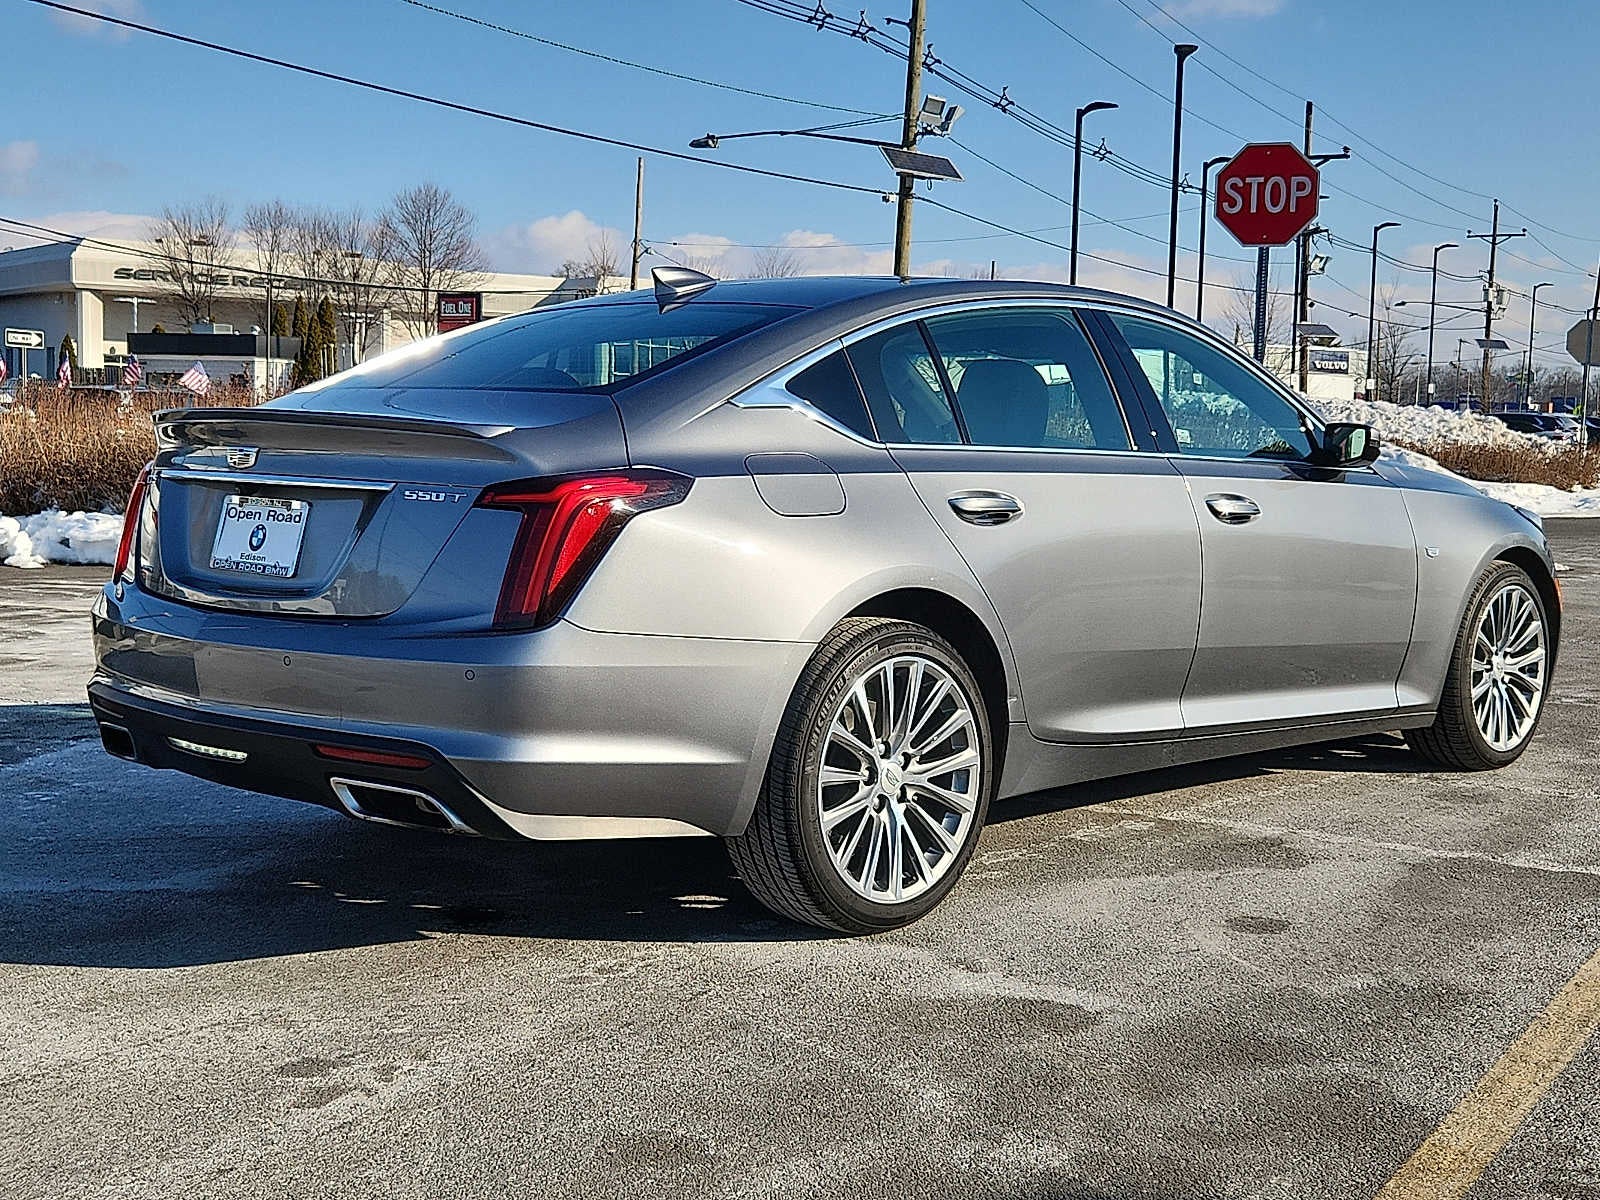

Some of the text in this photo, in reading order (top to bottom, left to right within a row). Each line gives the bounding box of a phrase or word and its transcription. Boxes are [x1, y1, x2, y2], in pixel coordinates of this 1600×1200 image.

[1222, 176, 1312, 214] STOP
[441, 301, 471, 313] FUEL ONE
[1314, 361, 1347, 370] VOLVO
[227, 506, 303, 524] Open Road
[240, 552, 266, 562] Edison
[214, 560, 288, 576] OPEN ROAD BMW
[810, 673, 846, 748] MICHELIN
